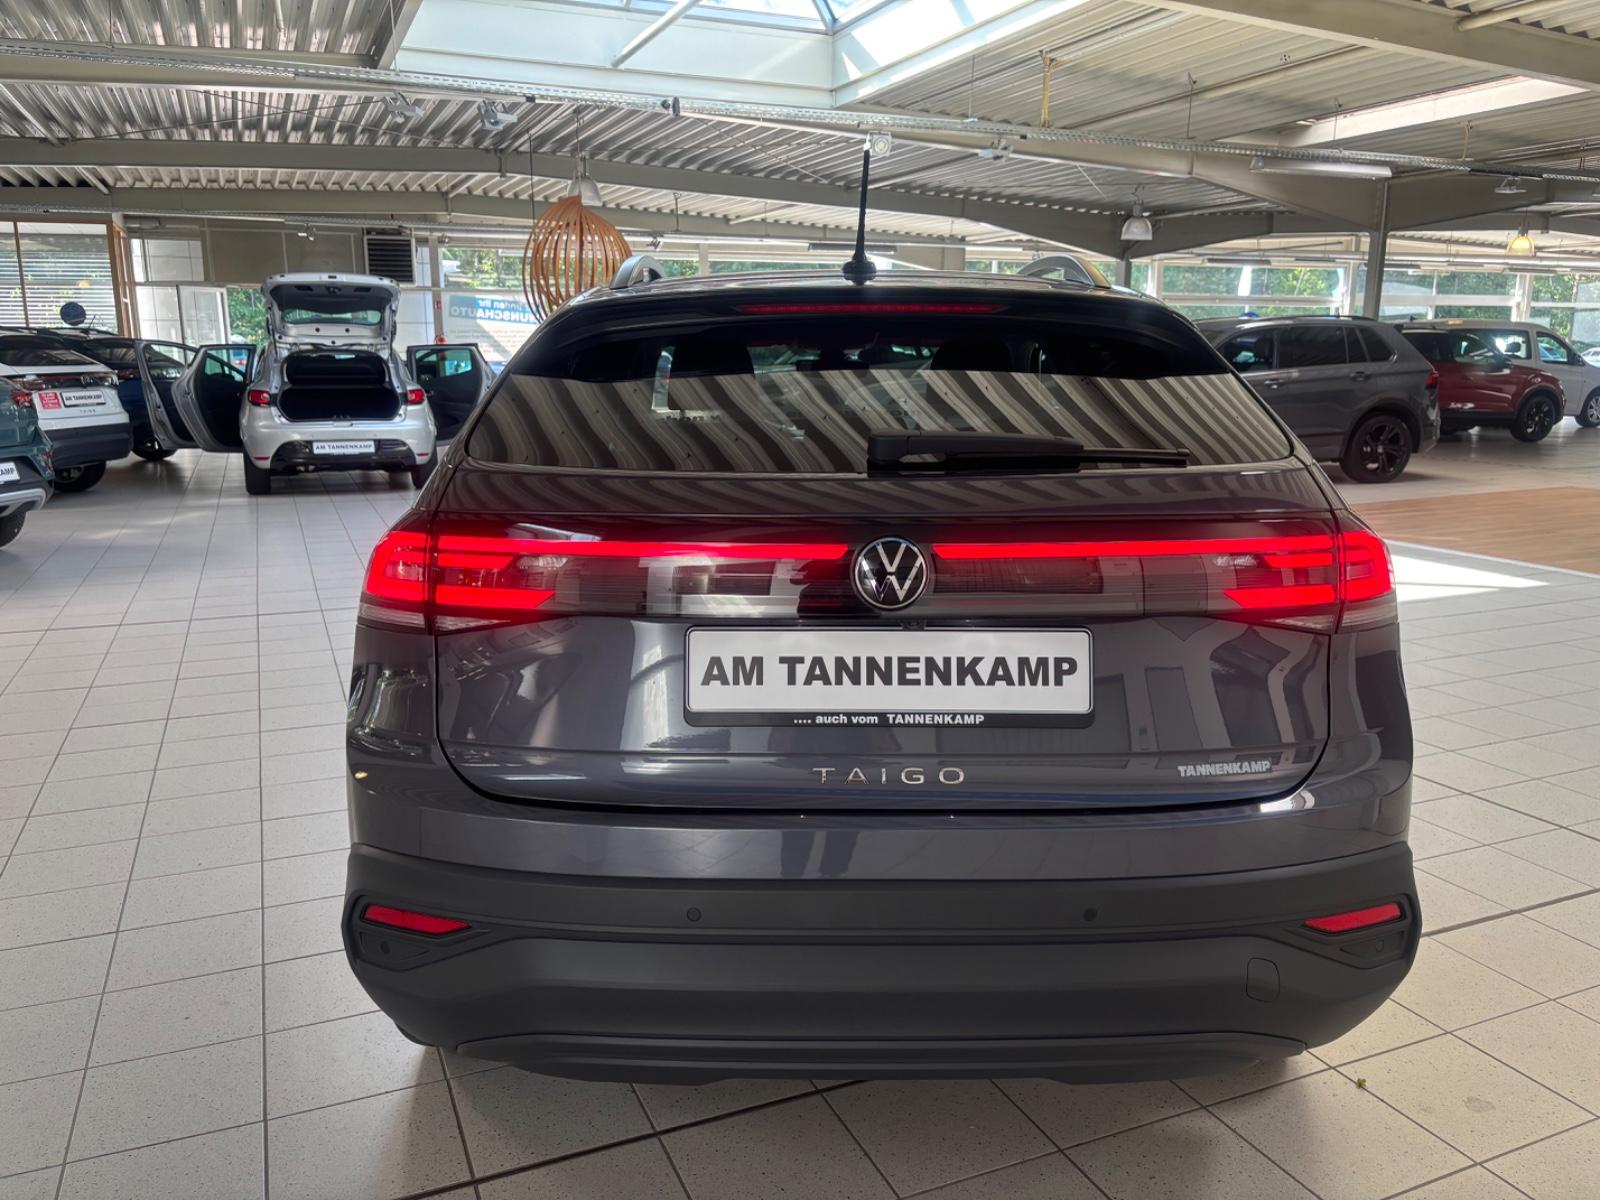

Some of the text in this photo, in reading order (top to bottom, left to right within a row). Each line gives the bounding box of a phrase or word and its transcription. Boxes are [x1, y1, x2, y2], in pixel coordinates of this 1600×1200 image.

[701, 656, 1078, 687] AM TANNENKAMP
[815, 714, 847, 724] auch
[851, 715, 879, 724] vom
[887, 713, 985, 725] TANNENKAMP
[812, 767, 965, 785] TAIGO
[1177, 760, 1272, 777] TANNENKAMP
